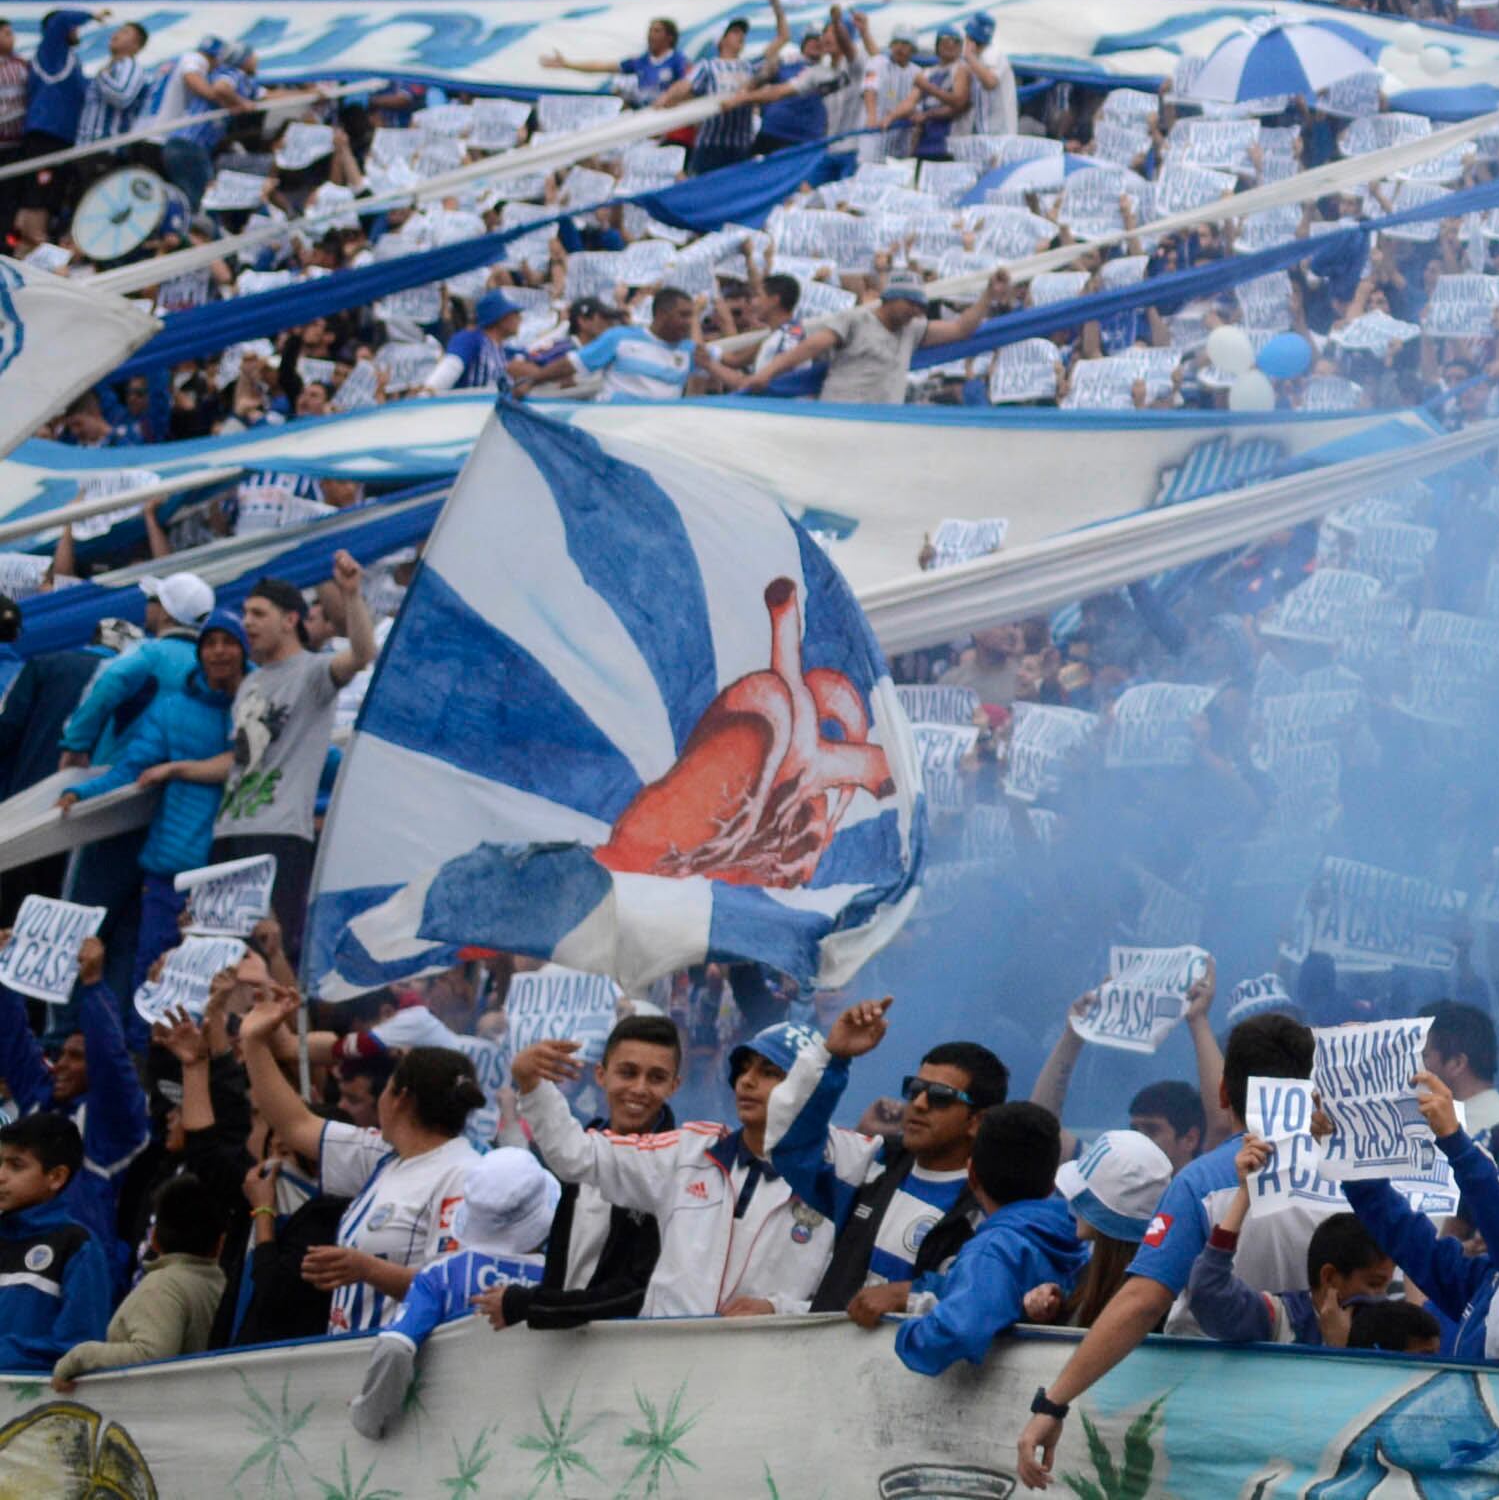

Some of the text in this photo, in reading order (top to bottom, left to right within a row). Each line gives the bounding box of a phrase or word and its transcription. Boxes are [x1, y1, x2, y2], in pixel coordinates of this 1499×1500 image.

[509, 974, 618, 1016] VOLVAMOS
[1100, 989, 1155, 1036] CASA
[1326, 1102, 1345, 1160] A
[1338, 1098, 1408, 1160] CASA
